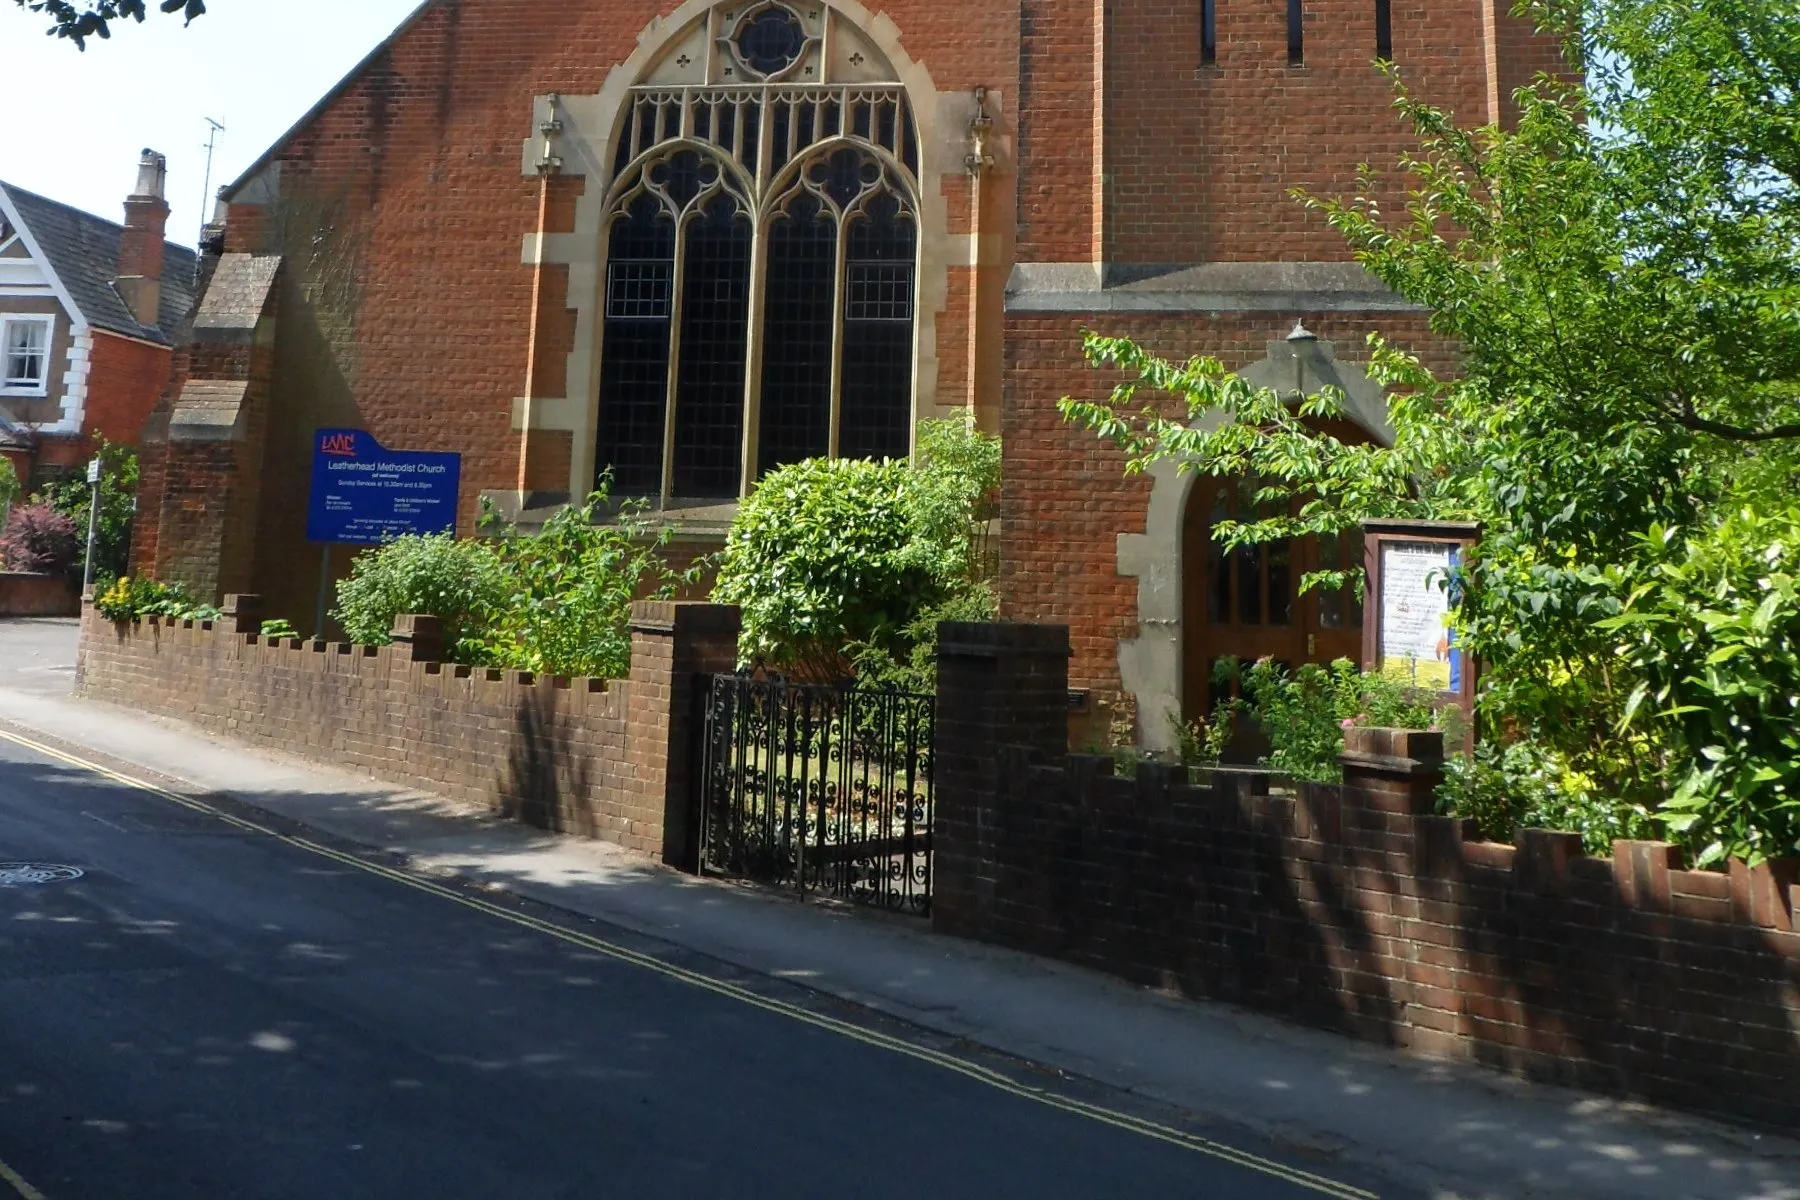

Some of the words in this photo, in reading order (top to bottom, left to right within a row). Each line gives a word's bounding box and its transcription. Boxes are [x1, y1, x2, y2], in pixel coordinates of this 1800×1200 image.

[328, 461, 376, 471] Leatherhead
[377, 462, 416, 473] Methodist
[417, 463, 446, 474] Church
